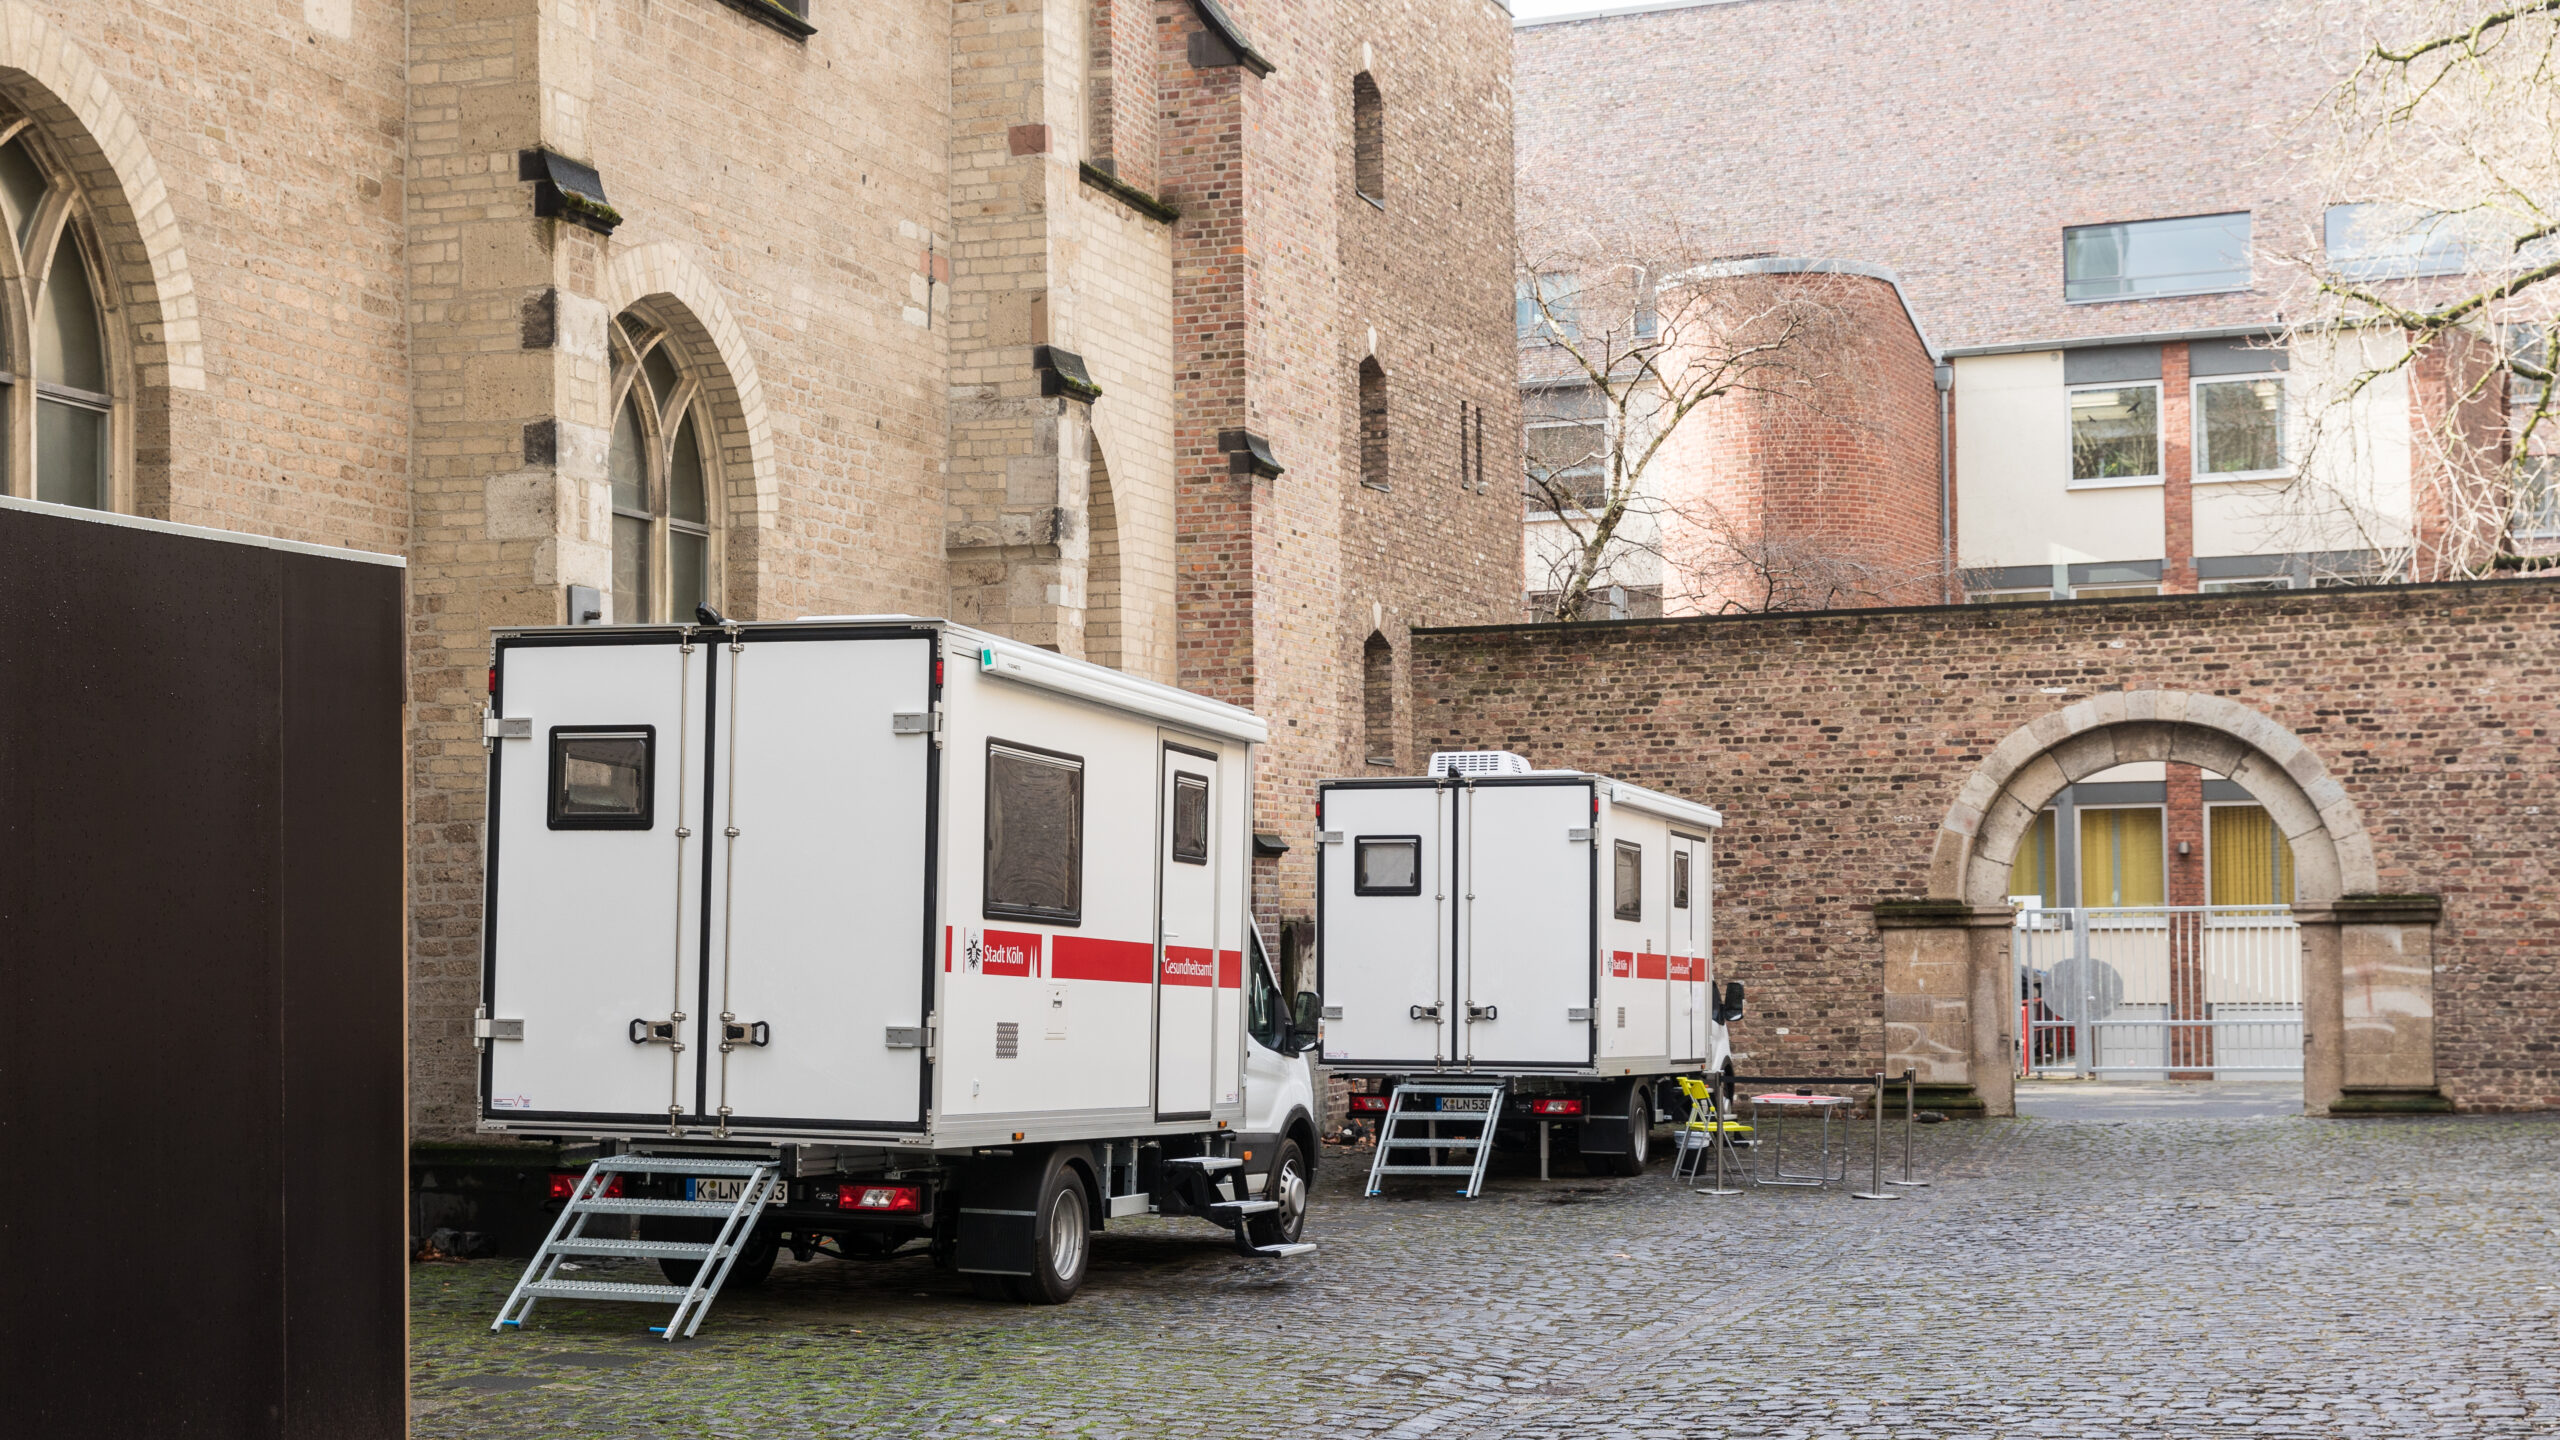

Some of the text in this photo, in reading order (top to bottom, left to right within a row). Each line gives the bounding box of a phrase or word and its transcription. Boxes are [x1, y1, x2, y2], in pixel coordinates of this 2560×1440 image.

[984, 944, 1024, 965] Stadt Köln
[1164, 957, 1213, 977] Gesundheitsamt
[1442, 1099, 1449, 1110] K
[696, 1181, 706, 1199] K
